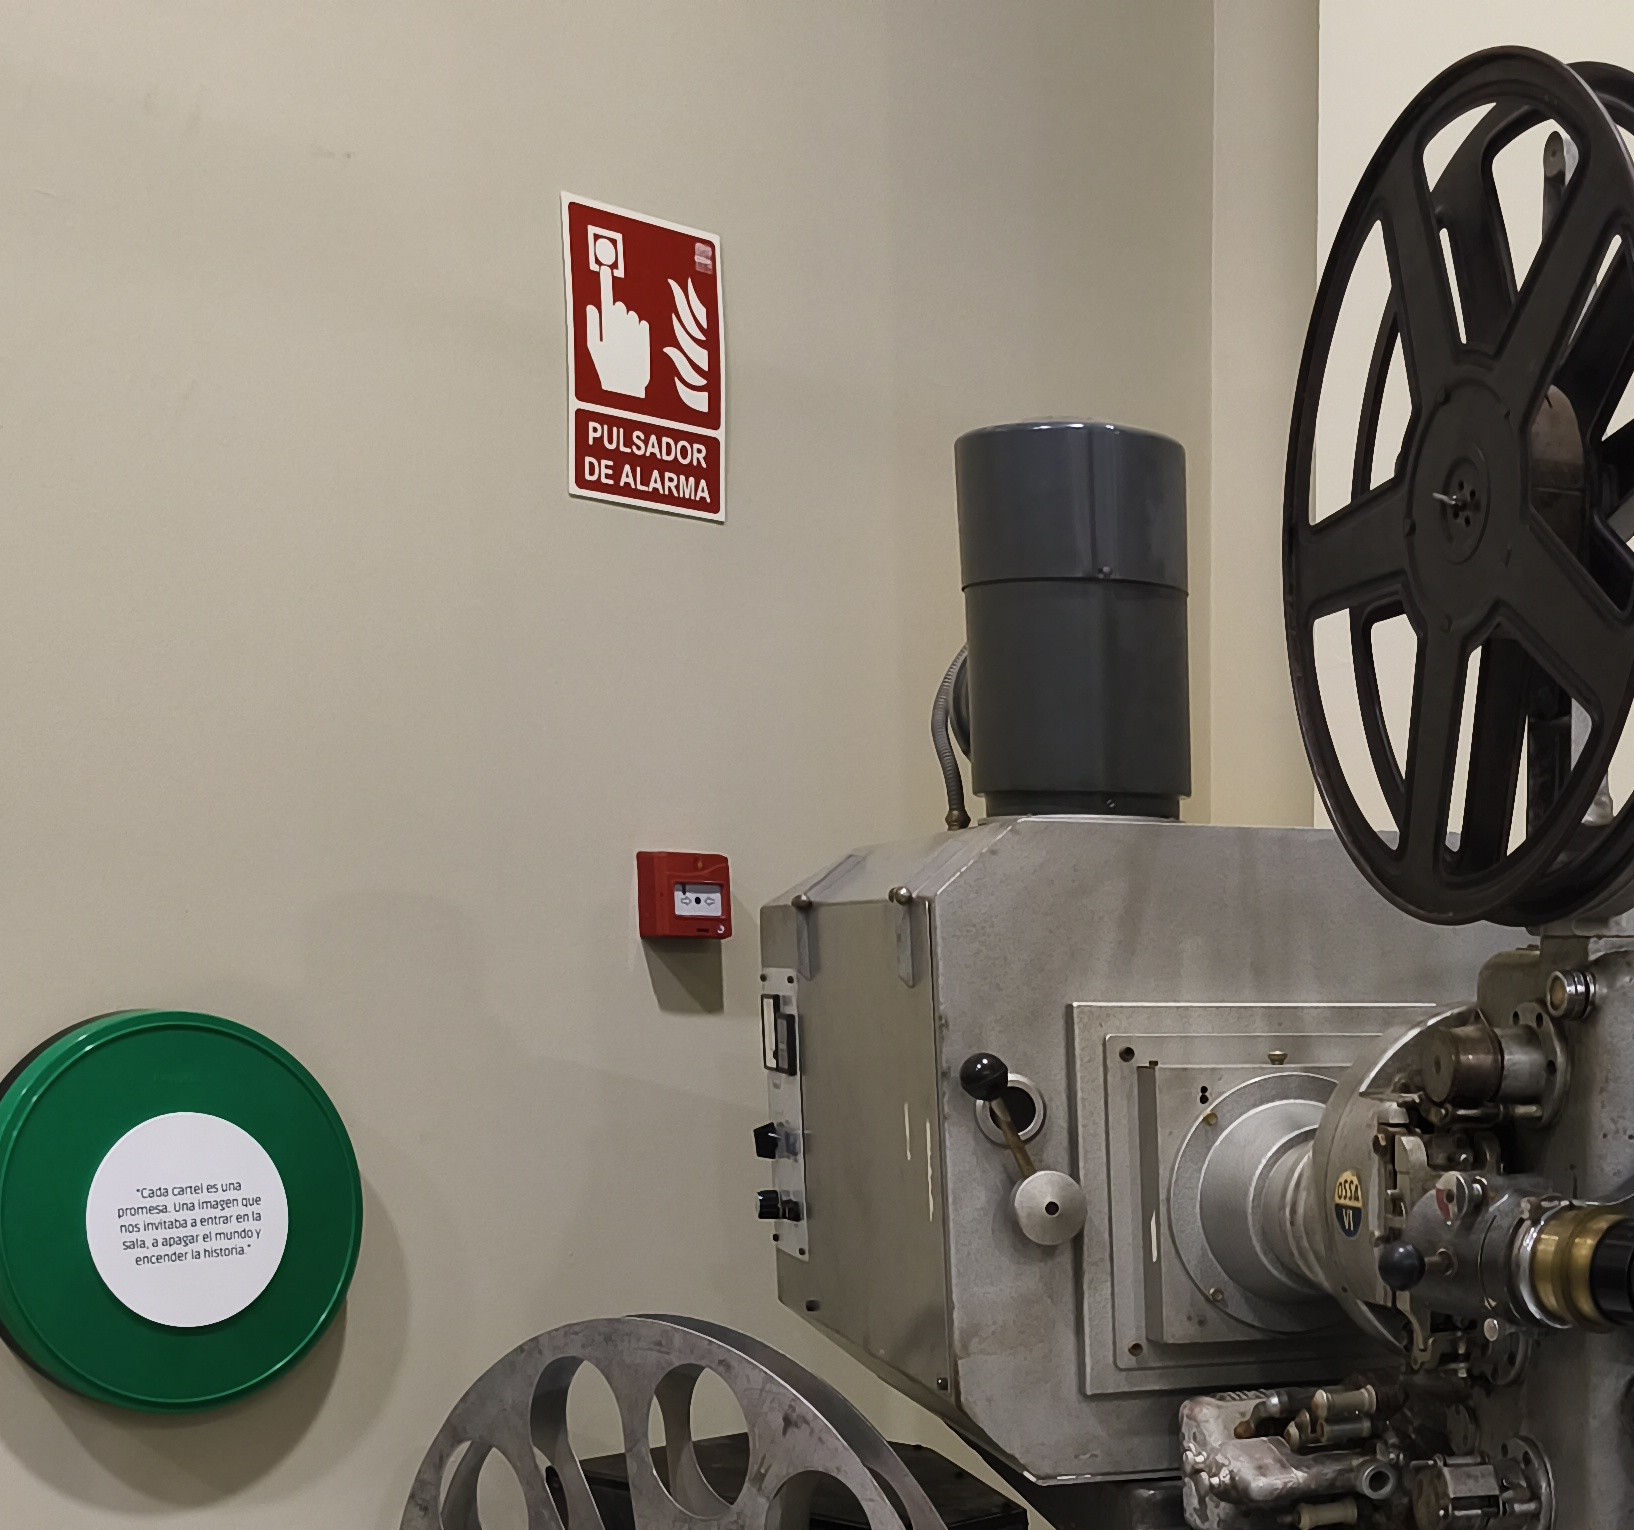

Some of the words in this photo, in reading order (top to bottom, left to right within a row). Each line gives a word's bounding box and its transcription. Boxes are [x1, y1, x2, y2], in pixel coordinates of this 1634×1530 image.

[588, 420, 708, 469] PULSADOR
[584, 456, 615, 486] DE
[619, 463, 712, 504] ALARMA
[171, 1182, 204, 1197] cartel
[206, 1183, 219, 1194] es
[220, 1181, 242, 1193] una
[1337, 1179, 1360, 1202] OSSA
[117, 1204, 172, 1219] promesa.
[173, 1200, 196, 1213] Una
[197, 1198, 239, 1212] imagen
[241, 1195, 262, 1208] que
[119, 1221, 141, 1235] nos
[143, 1218, 188, 1232] invitaba
[190, 1217, 198, 1228] a
[199, 1213, 234, 1227] entrar
[235, 1213, 250, 1223] en
[251, 1211, 262, 1222] la
[1342, 1208, 1354, 1231] VI
[122, 1238, 150, 1251] sala,
[151, 1237, 159, 1248] a
[161, 1233, 200, 1248] apagar
[202, 1230, 213, 1243] el
[215, 1228, 254, 1242] mundo
[254, 1227, 262, 1240] y
[135, 1249, 189, 1266] encender
[191, 1248, 201, 1260] la
